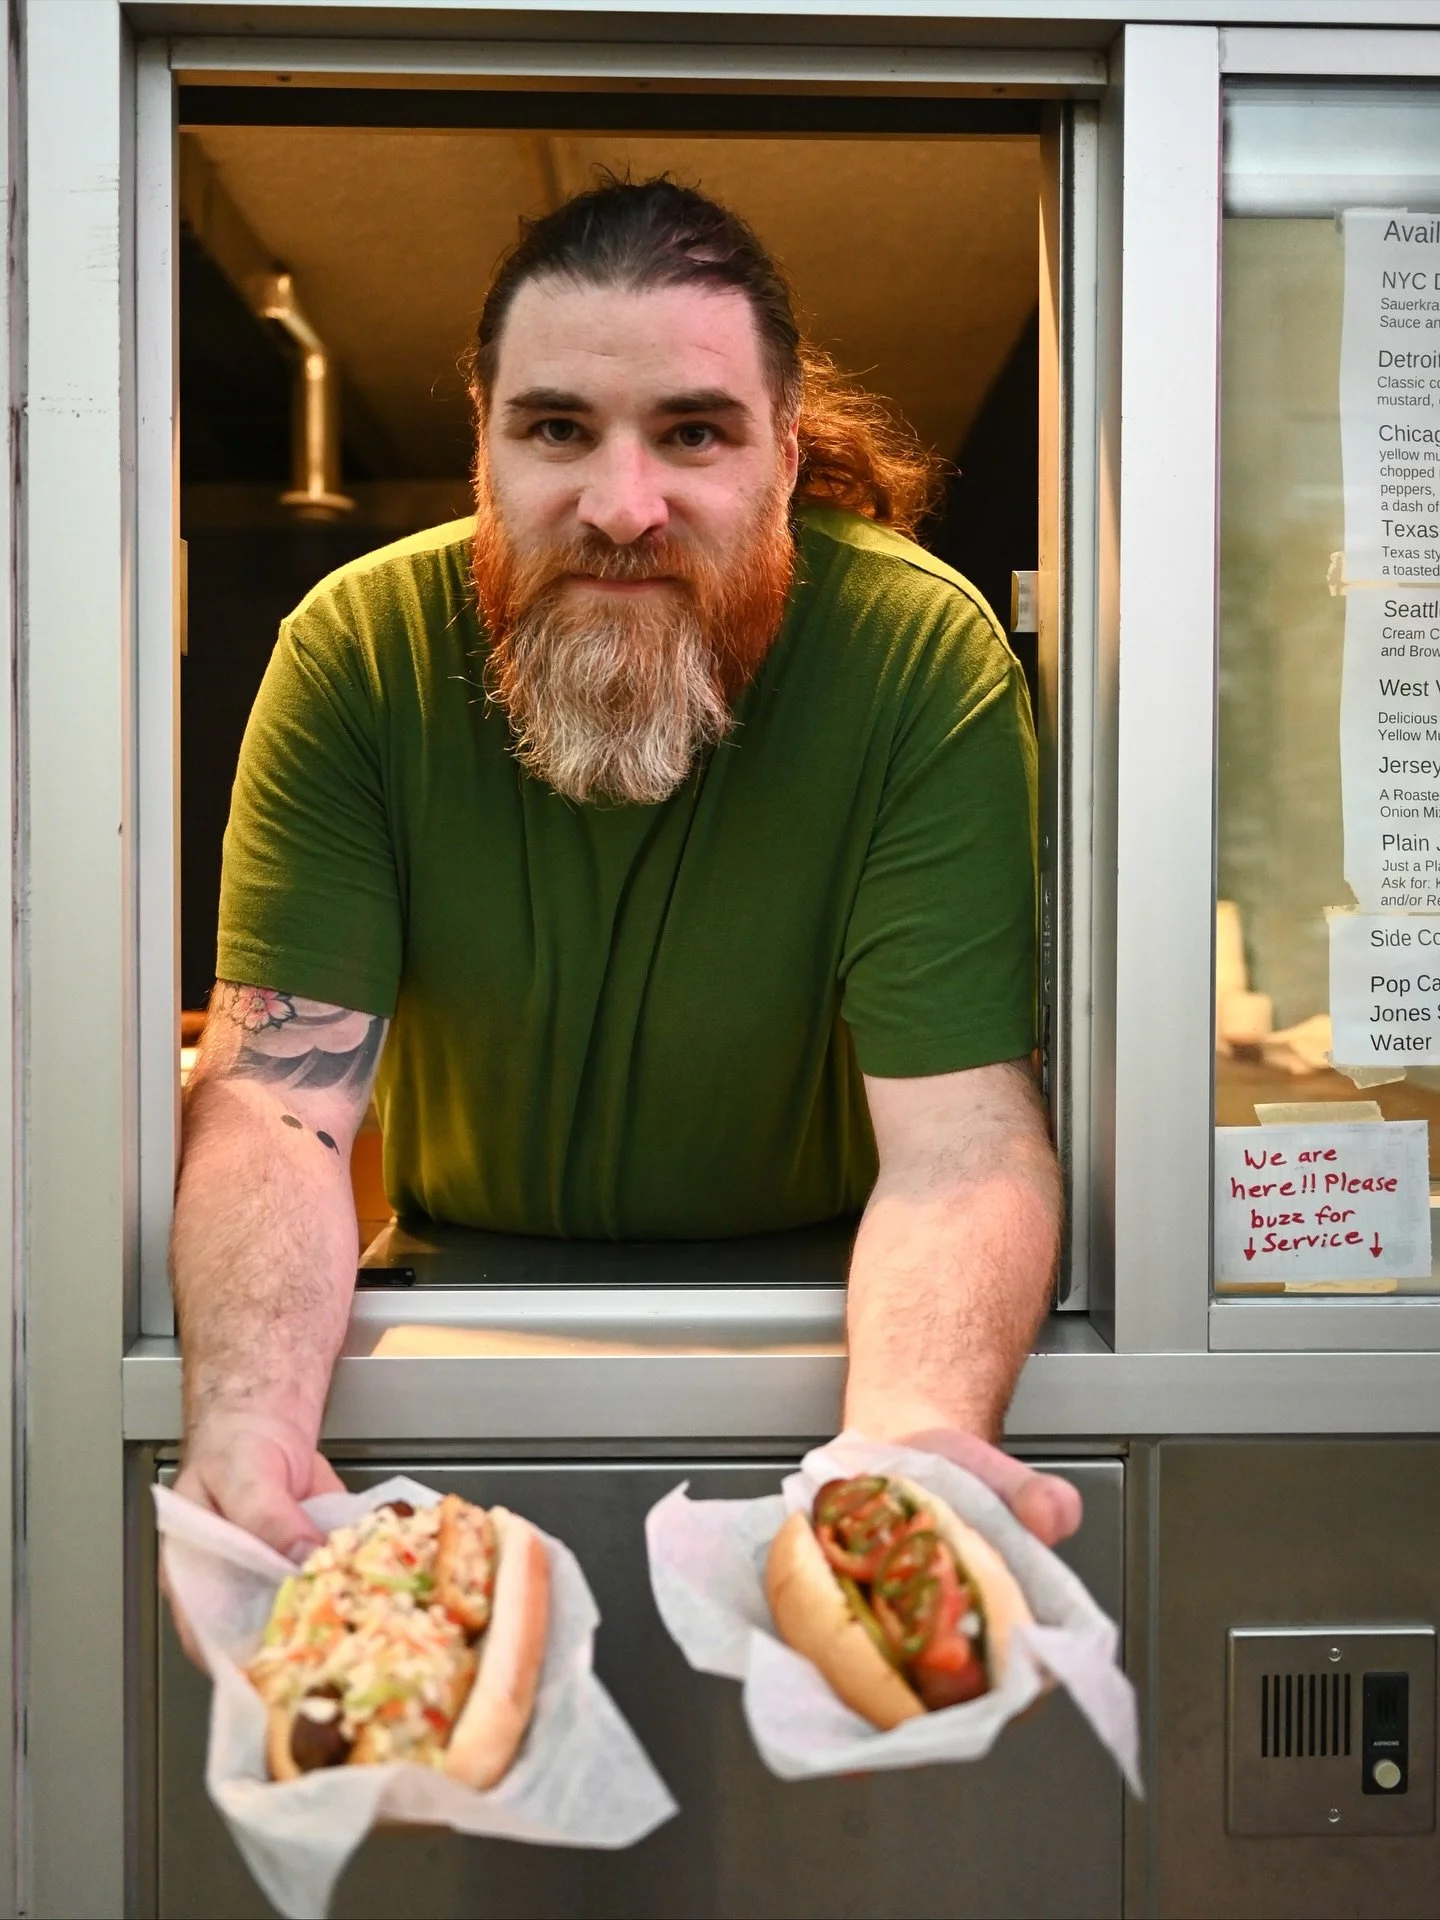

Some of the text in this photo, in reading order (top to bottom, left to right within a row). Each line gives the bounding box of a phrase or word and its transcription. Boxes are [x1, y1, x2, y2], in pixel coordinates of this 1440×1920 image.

[1383, 220, 1440, 243] Avail
[1382, 271, 1427, 290] NYC
[1380, 297, 1440, 311] Sauerkra
[1380, 315, 1420, 328] Sauce
[1377, 376, 1425, 388] Classic
[1377, 394, 1434, 408] mustard,
[1379, 448, 1419, 462] yellow
[1380, 465, 1434, 480] chopped
[1380, 484, 1435, 497] peppers,
[1381, 500, 1440, 513] a dash of
[1381, 519, 1438, 538] Texas
[1381, 546, 1420, 559] Texas
[1382, 565, 1440, 577] a toasted
[1384, 600, 1440, 618] Seattl
[1382, 627, 1440, 640] Cream C
[1381, 644, 1440, 657] and Brow
[1379, 679, 1429, 697] West
[1379, 711, 1438, 724] Delicious
[1378, 729, 1421, 741] Yellow
[1379, 756, 1440, 778] Jersey
[1379, 788, 1440, 801] A Roaste
[1380, 805, 1440, 818] Onion Mi
[1382, 833, 1429, 851] Plain
[1382, 860, 1440, 872] Just a Pl
[1381, 877, 1406, 889] Ask
[1411, 877, 1430, 889] for:
[1381, 894, 1422, 906] and/or
[1370, 929, 1440, 947] Side Co
[1371, 975, 1440, 997] Pop Ca
[1370, 1005, 1431, 1022] Jones
[1370, 1034, 1432, 1051] Water
[1244, 1148, 1338, 1169] We are
[1230, 1172, 1399, 1200] here!! Please
[1250, 1205, 1356, 1229] buzz for
[1262, 1230, 1364, 1253] Service
